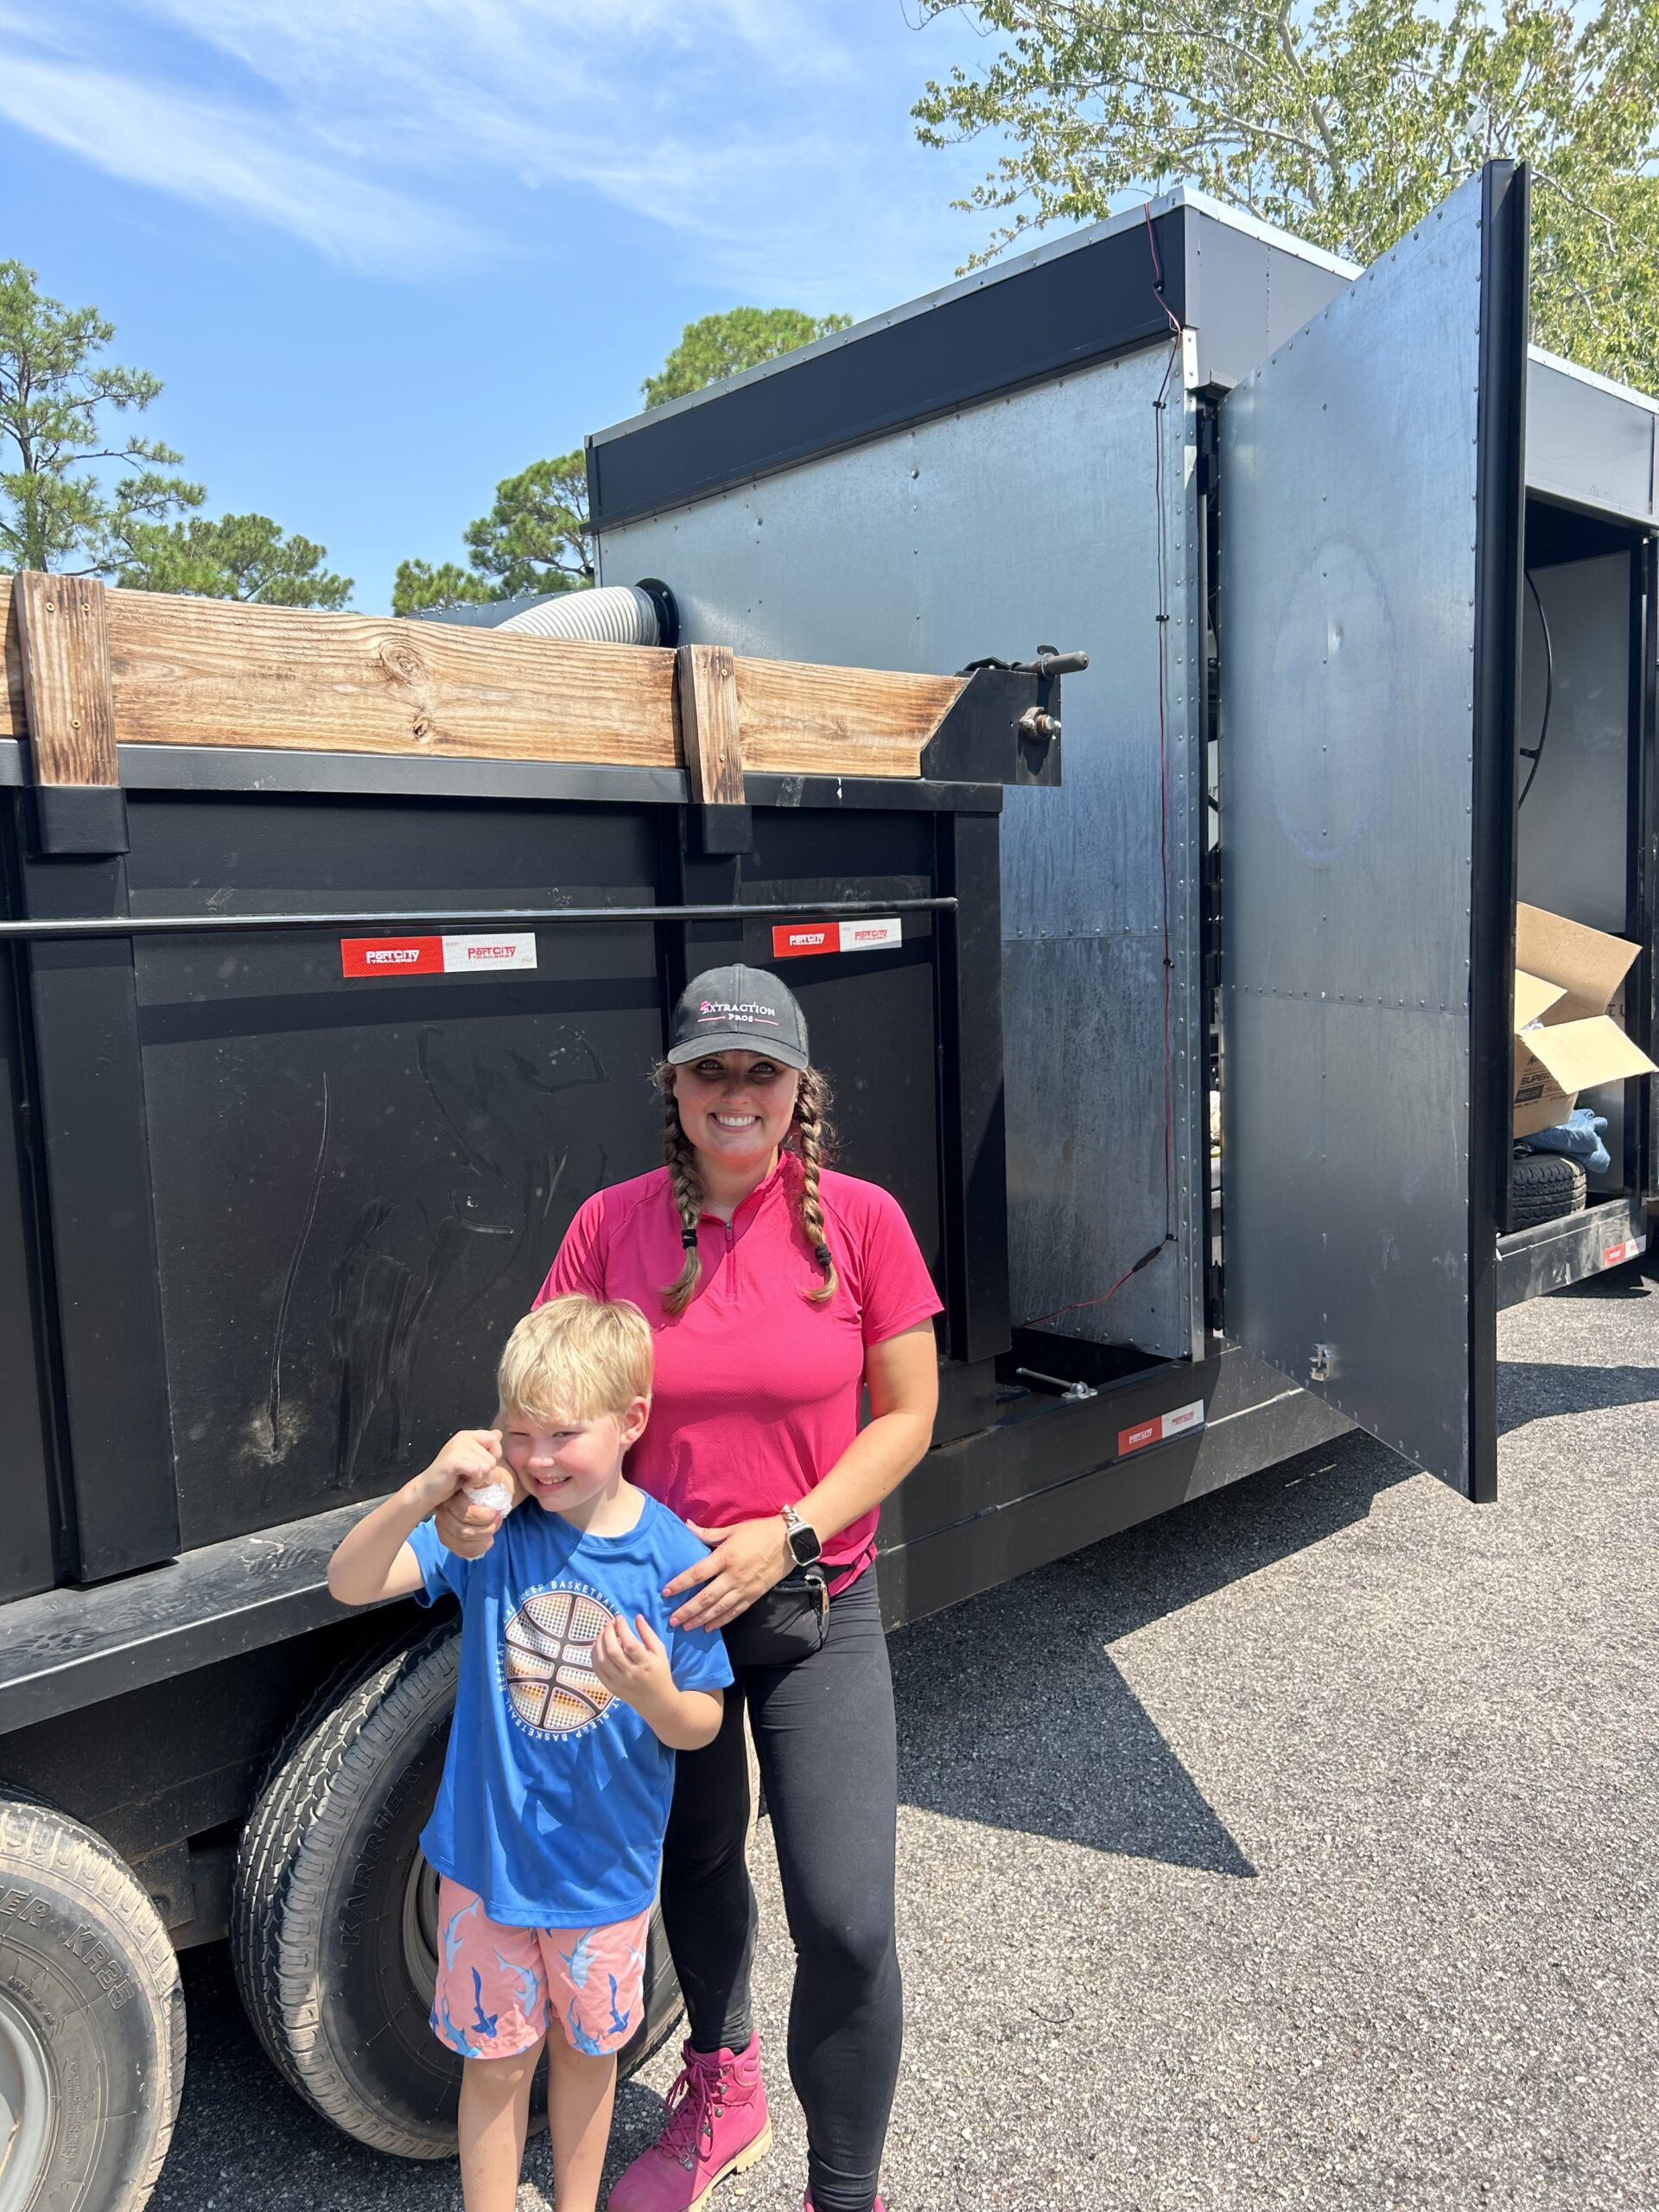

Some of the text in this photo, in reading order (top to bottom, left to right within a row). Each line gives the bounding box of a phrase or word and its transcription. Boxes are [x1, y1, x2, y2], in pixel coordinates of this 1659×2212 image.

[728, 1013, 753, 1023] PROS
[496, 1641, 507, 1692] REPEAT
[505, 1697, 569, 1742] BASKETBALL
[341, 1765, 422, 1946] KARRIER
[64, 1923, 135, 2011] KR35
